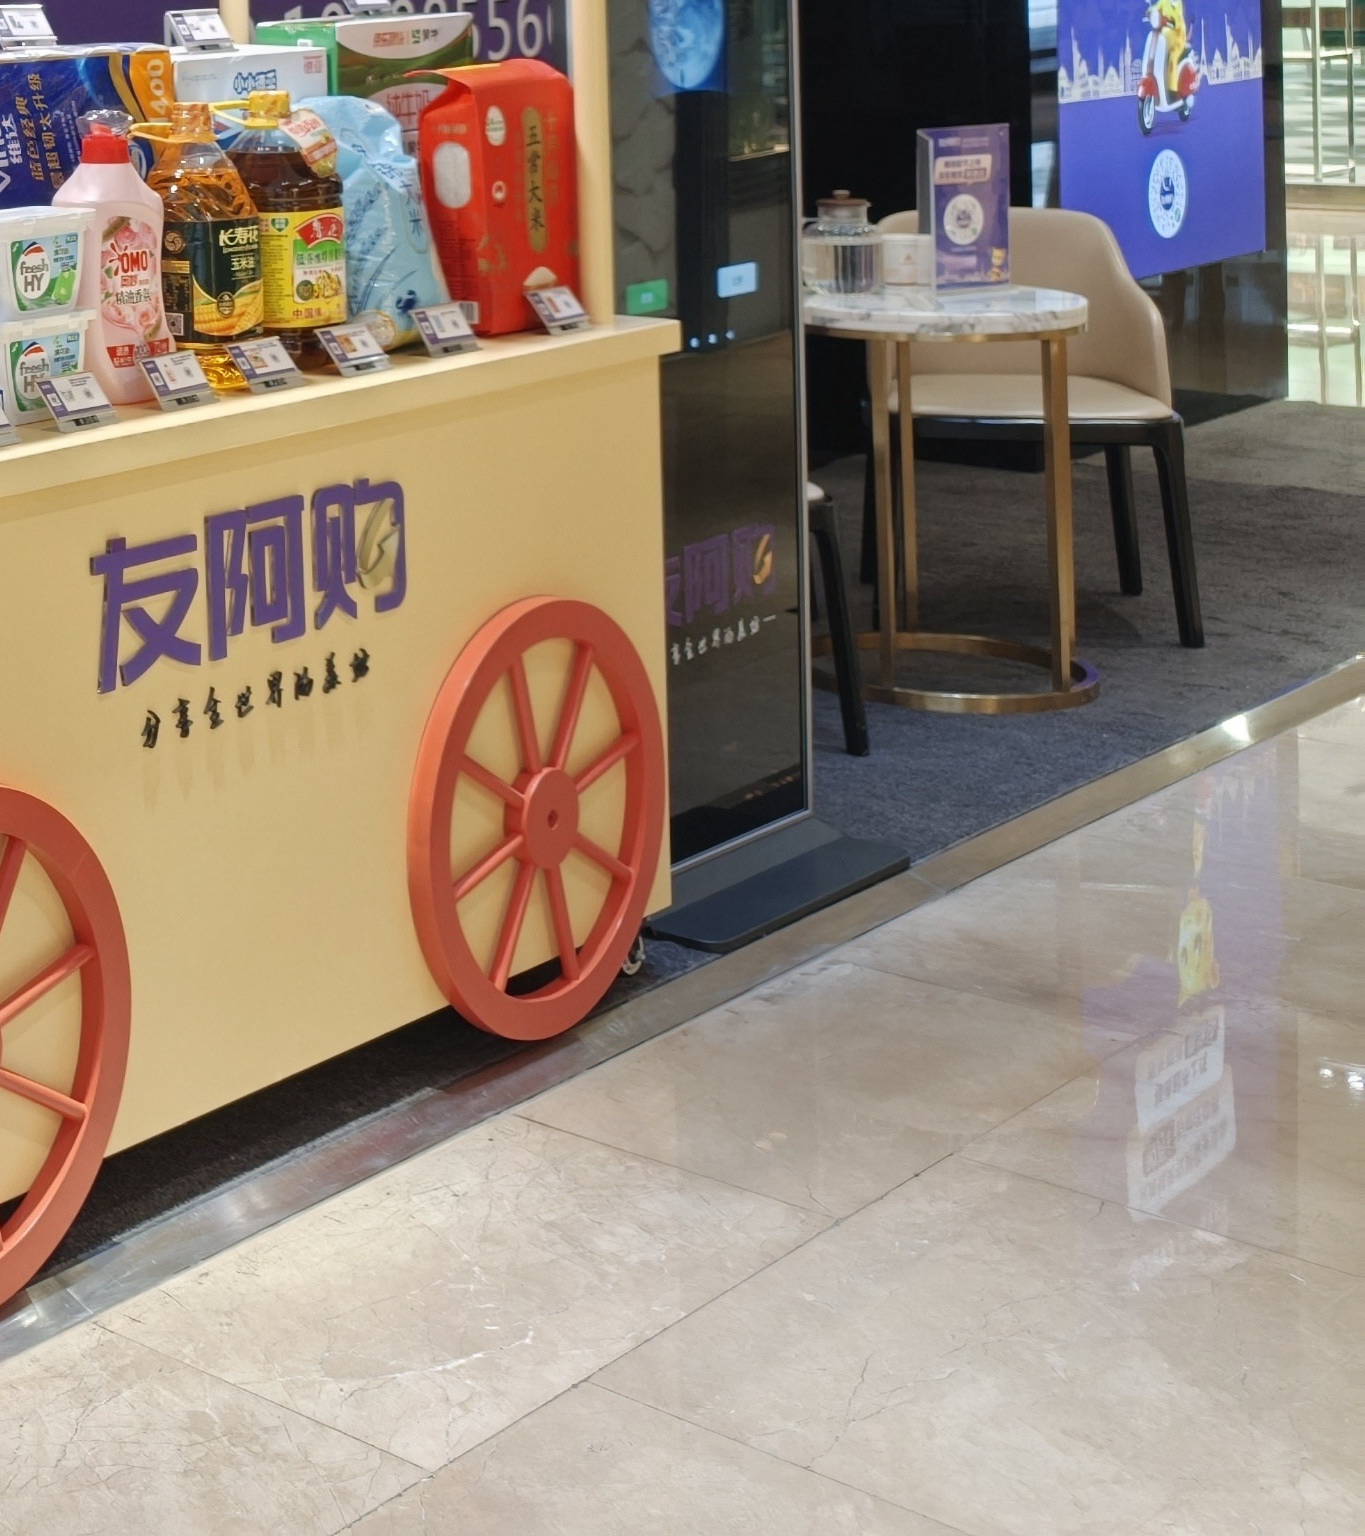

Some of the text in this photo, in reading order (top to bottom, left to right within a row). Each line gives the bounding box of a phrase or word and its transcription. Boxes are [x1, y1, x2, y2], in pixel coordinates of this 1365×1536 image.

[3, 113, 23, 165] 维达
[15, 95, 45, 182] 蓝色经典
[218, 225, 259, 246] 长寿花
[121, 250, 149, 273] OMO
[24, 273, 46, 293] HY
[89, 477, 407, 694] 友阿购
